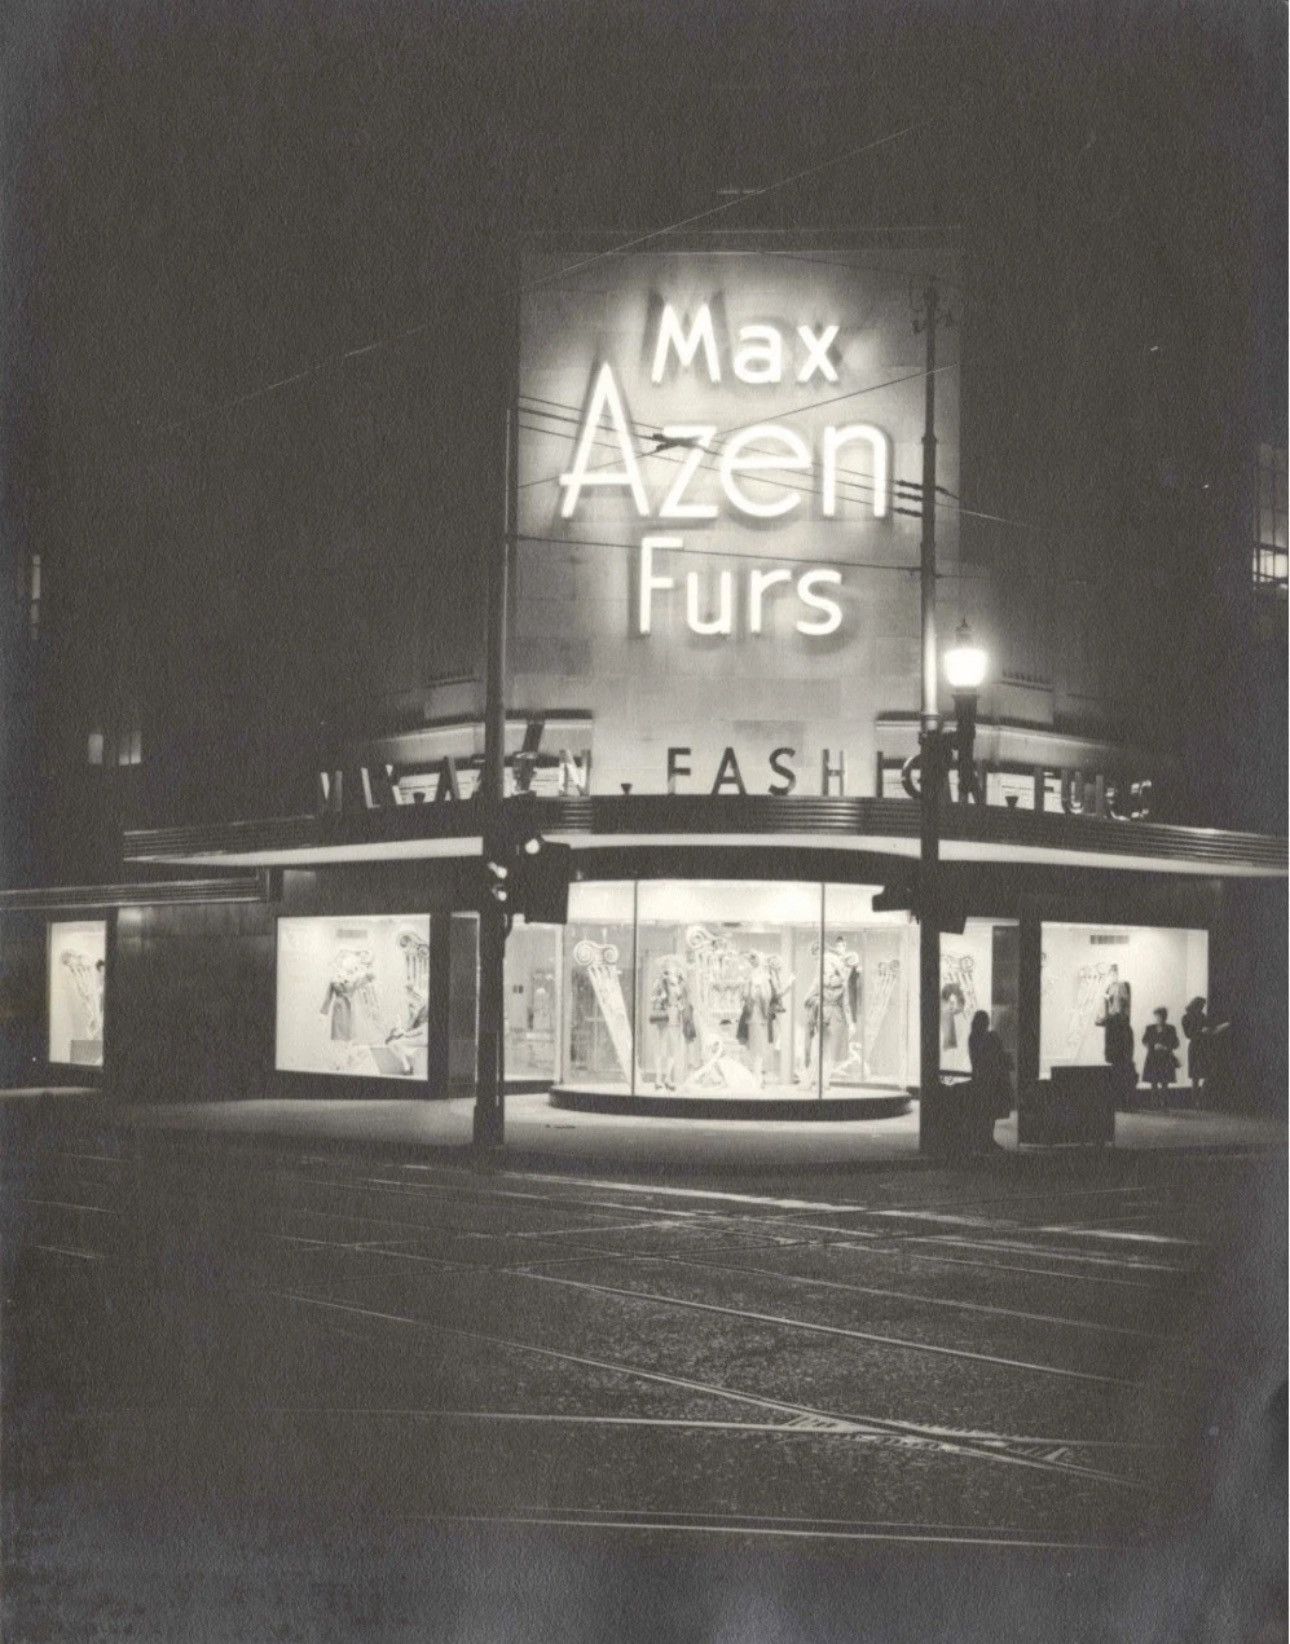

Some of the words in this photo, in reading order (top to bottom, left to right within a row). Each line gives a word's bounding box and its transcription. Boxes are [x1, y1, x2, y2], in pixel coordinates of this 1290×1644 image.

[651, 303, 840, 383] Max
[560, 361, 889, 518] Azen
[639, 536, 844, 636] Furs
